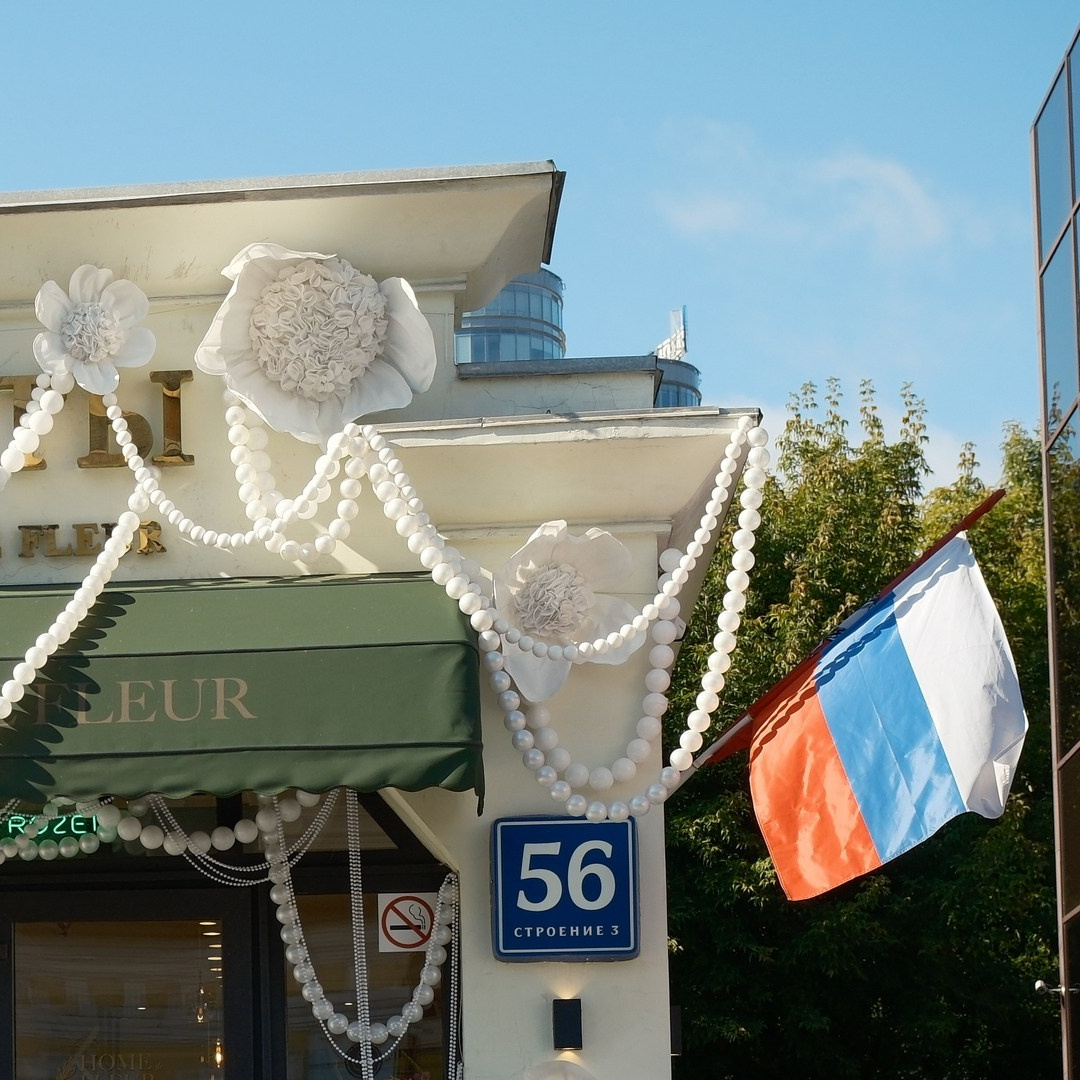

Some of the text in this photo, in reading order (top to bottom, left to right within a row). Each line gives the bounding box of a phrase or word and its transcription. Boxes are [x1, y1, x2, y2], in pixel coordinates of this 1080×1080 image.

[33, 677, 258, 725] FLEUR
[517, 840, 616, 912] 56
[514, 925, 619, 938] СТРОЕНИЕ 3
